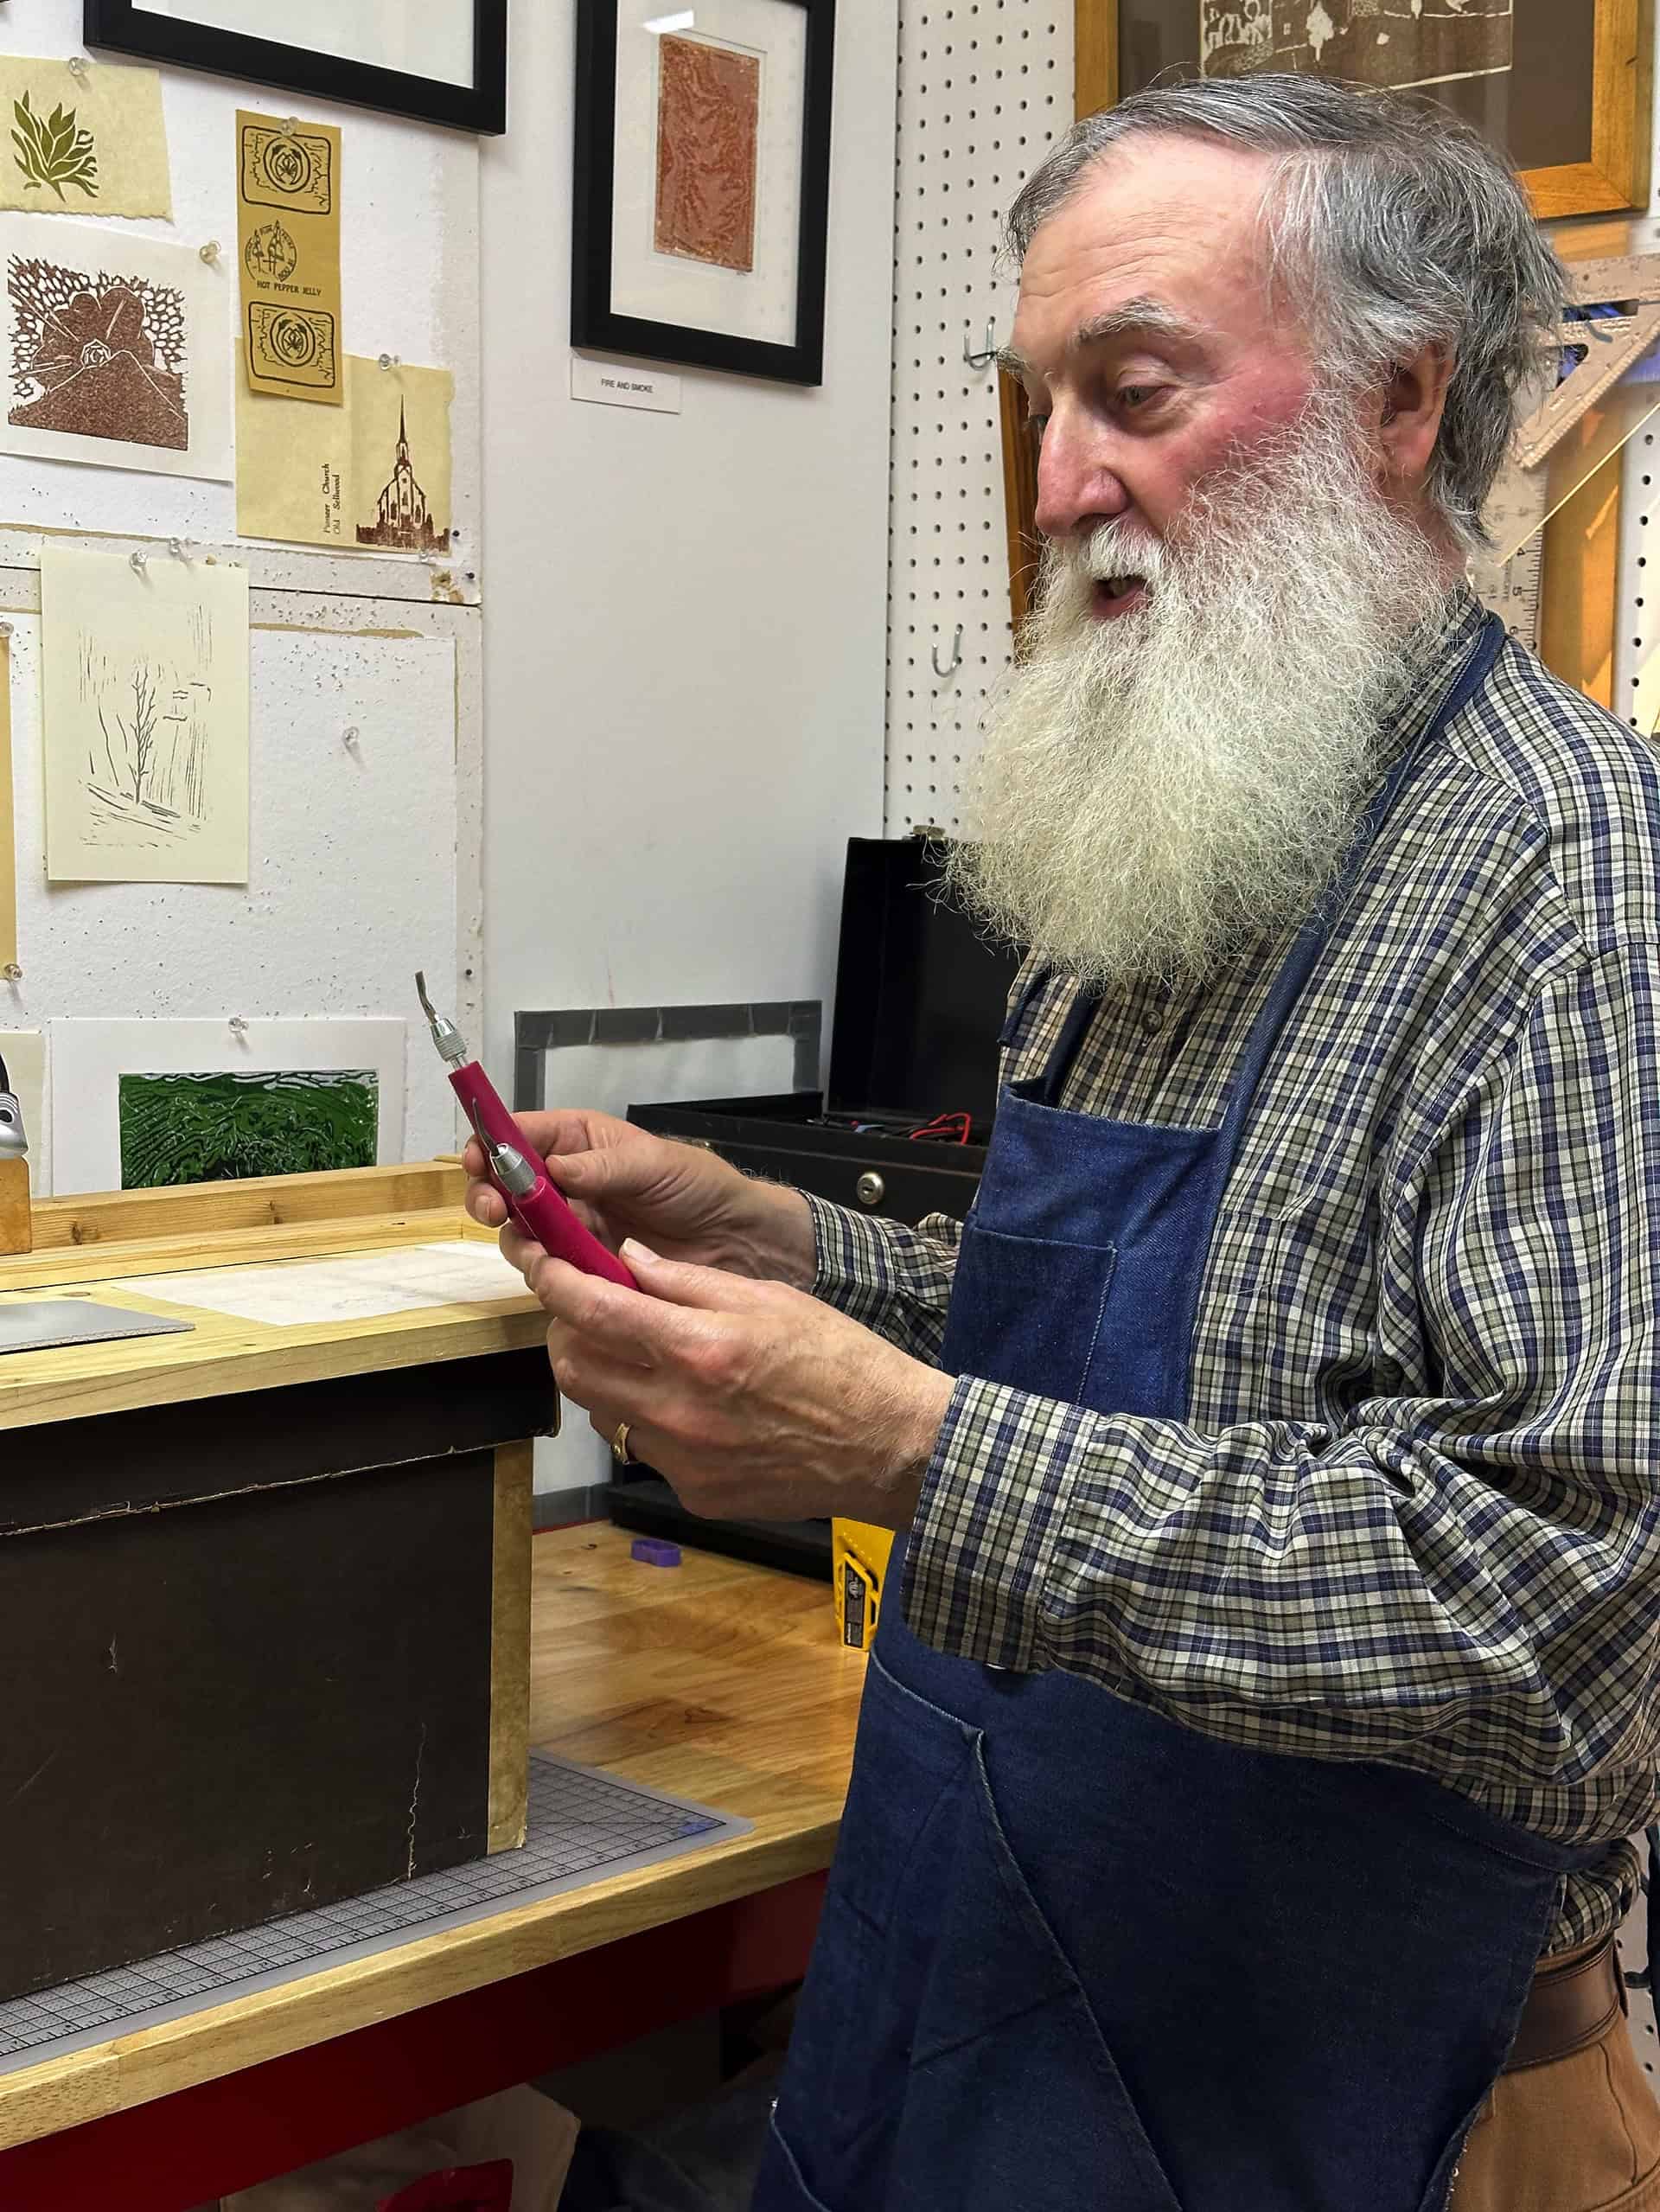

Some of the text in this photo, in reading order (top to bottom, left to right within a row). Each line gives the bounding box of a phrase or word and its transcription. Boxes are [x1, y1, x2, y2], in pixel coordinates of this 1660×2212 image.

[257, 280, 321, 296] HOT PEPPER JELLY
[602, 378, 654, 393] FIRE AND SMOKE
